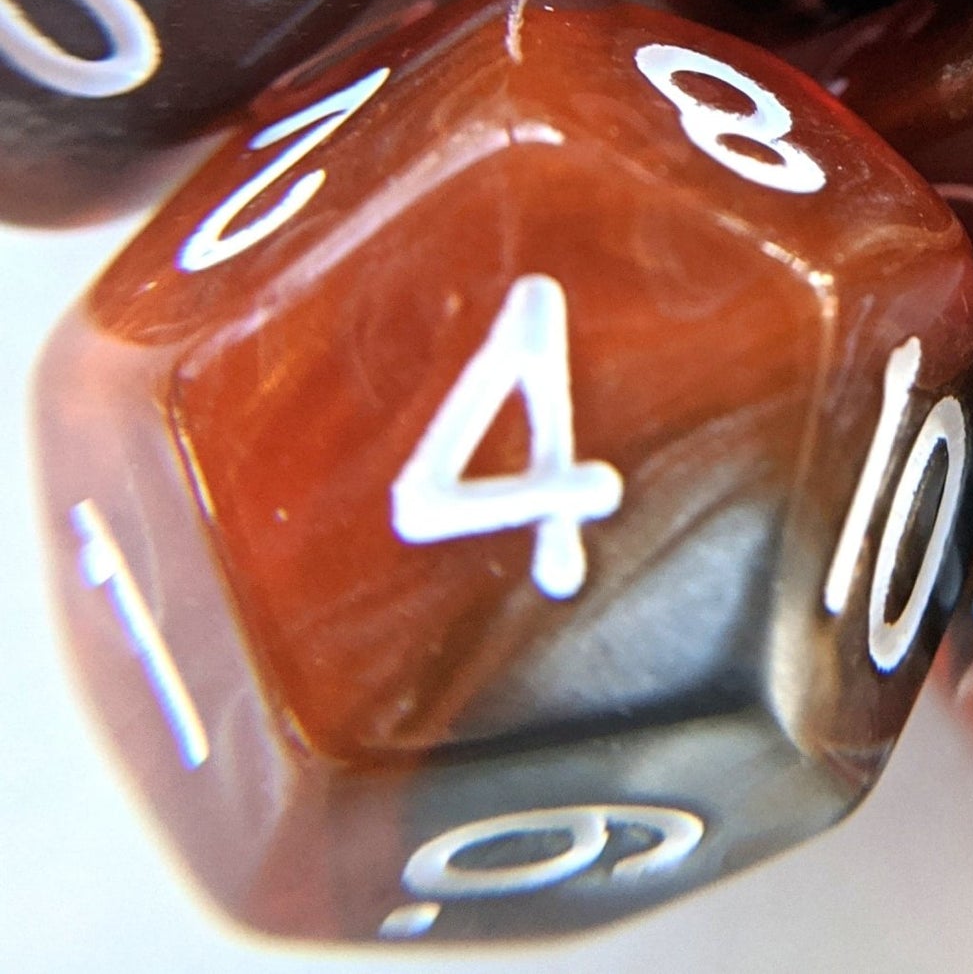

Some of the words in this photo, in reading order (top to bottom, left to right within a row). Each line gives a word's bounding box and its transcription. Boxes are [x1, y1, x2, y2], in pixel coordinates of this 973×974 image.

[635, 42, 827, 195] 8
[391, 273, 625, 600] 4
[823, 335, 967, 673] 10
[70, 497, 211, 772] 1
